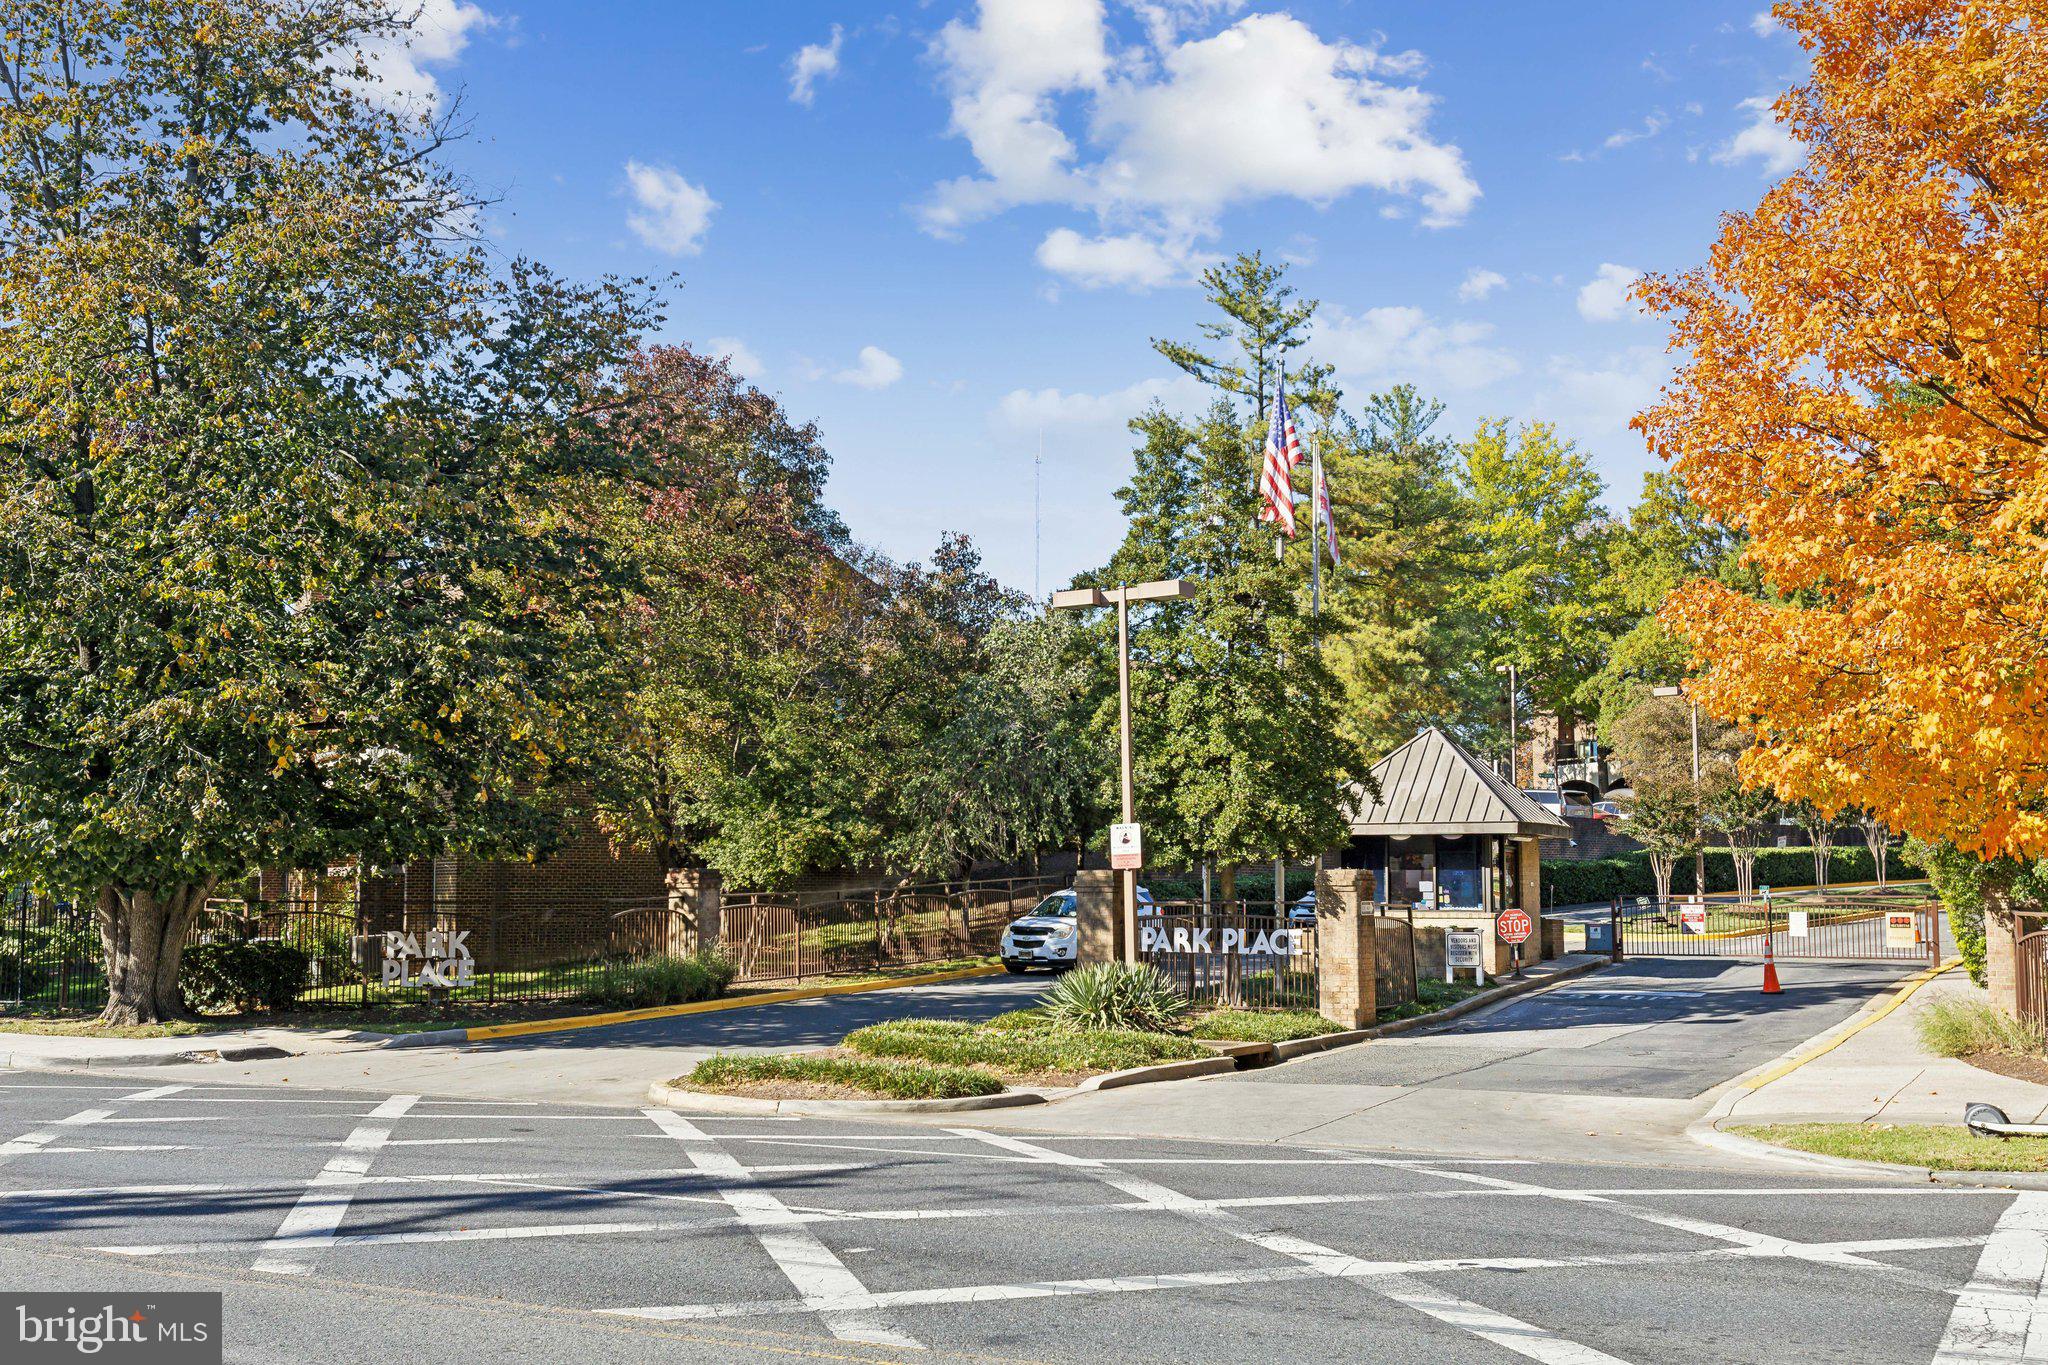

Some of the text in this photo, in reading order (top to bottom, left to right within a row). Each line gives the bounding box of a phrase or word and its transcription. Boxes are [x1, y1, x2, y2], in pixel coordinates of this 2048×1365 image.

[1499, 919, 1529, 933] STOP
[386, 931, 472, 960] PARK
[1141, 927, 1303, 955] PARK PLACE
[382, 959, 475, 987] PLACE
